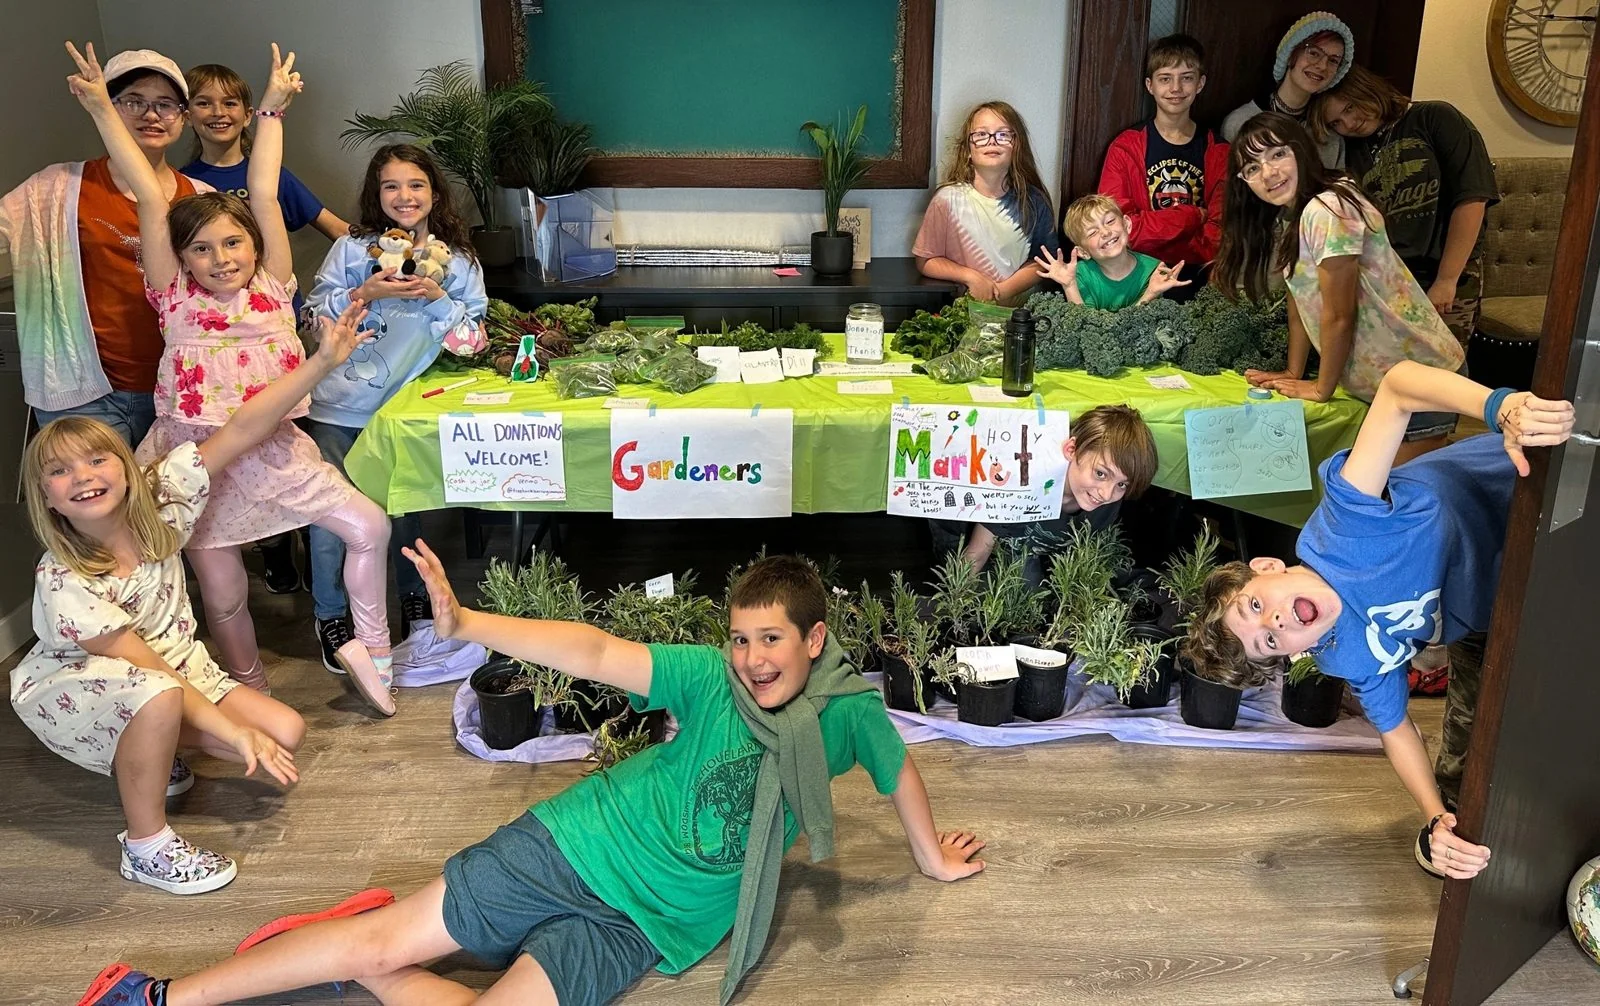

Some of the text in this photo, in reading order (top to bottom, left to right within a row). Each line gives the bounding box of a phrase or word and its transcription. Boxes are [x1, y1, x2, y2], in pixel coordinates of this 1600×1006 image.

[1147, 158, 1177, 176] ECLIPSE
[1188, 164, 1202, 177] THE
[787, 355, 807, 369] Dill
[452, 422, 562, 442] ALL DONATIONS
[464, 450, 549, 466] WELCOME!
[612, 436, 762, 492] Gardeners
[893, 424, 1033, 487] Market
[906, 482, 916, 490] All
